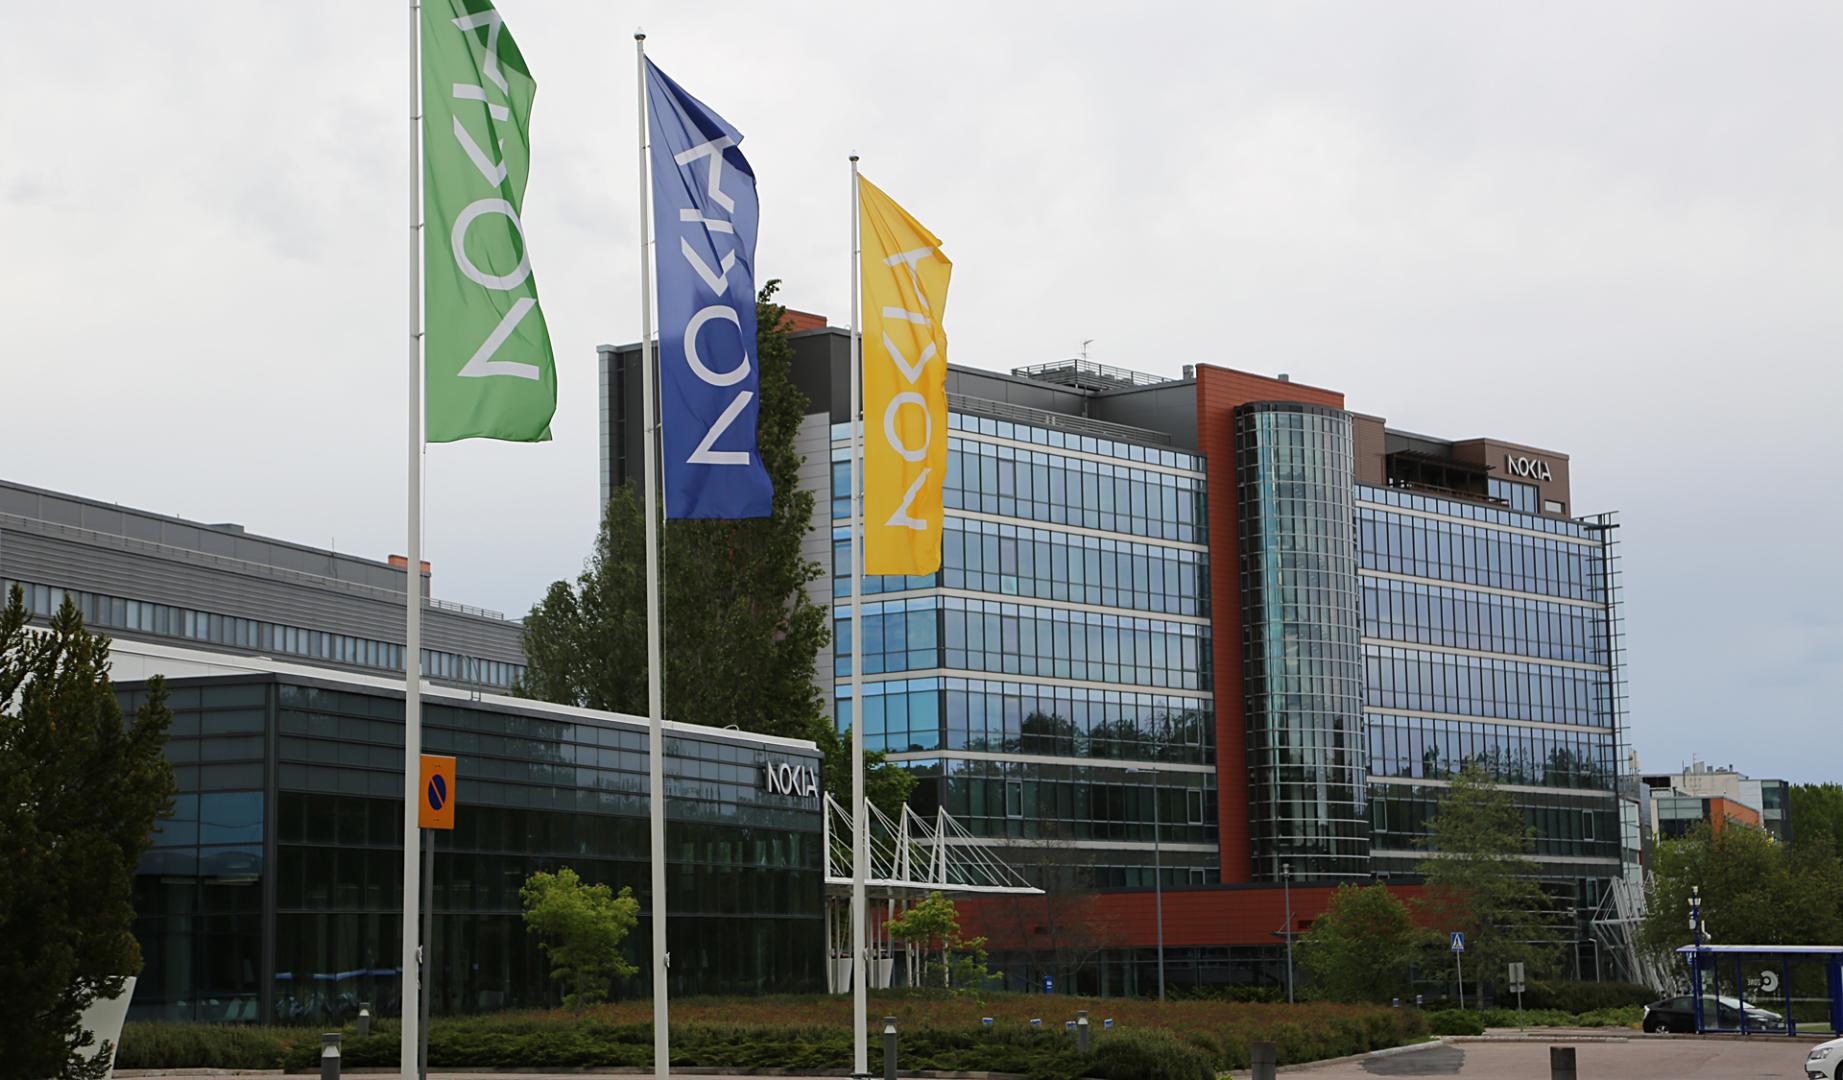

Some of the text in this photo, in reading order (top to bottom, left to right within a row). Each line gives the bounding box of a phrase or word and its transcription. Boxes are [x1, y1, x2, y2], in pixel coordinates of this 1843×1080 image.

[450, 9, 540, 380] NOKIA
[674, 134, 754, 465] NOKIA
[882, 246, 936, 530] NOKIA
[1507, 453, 1552, 482] NOKIA
[767, 760, 819, 798] NOKIA
